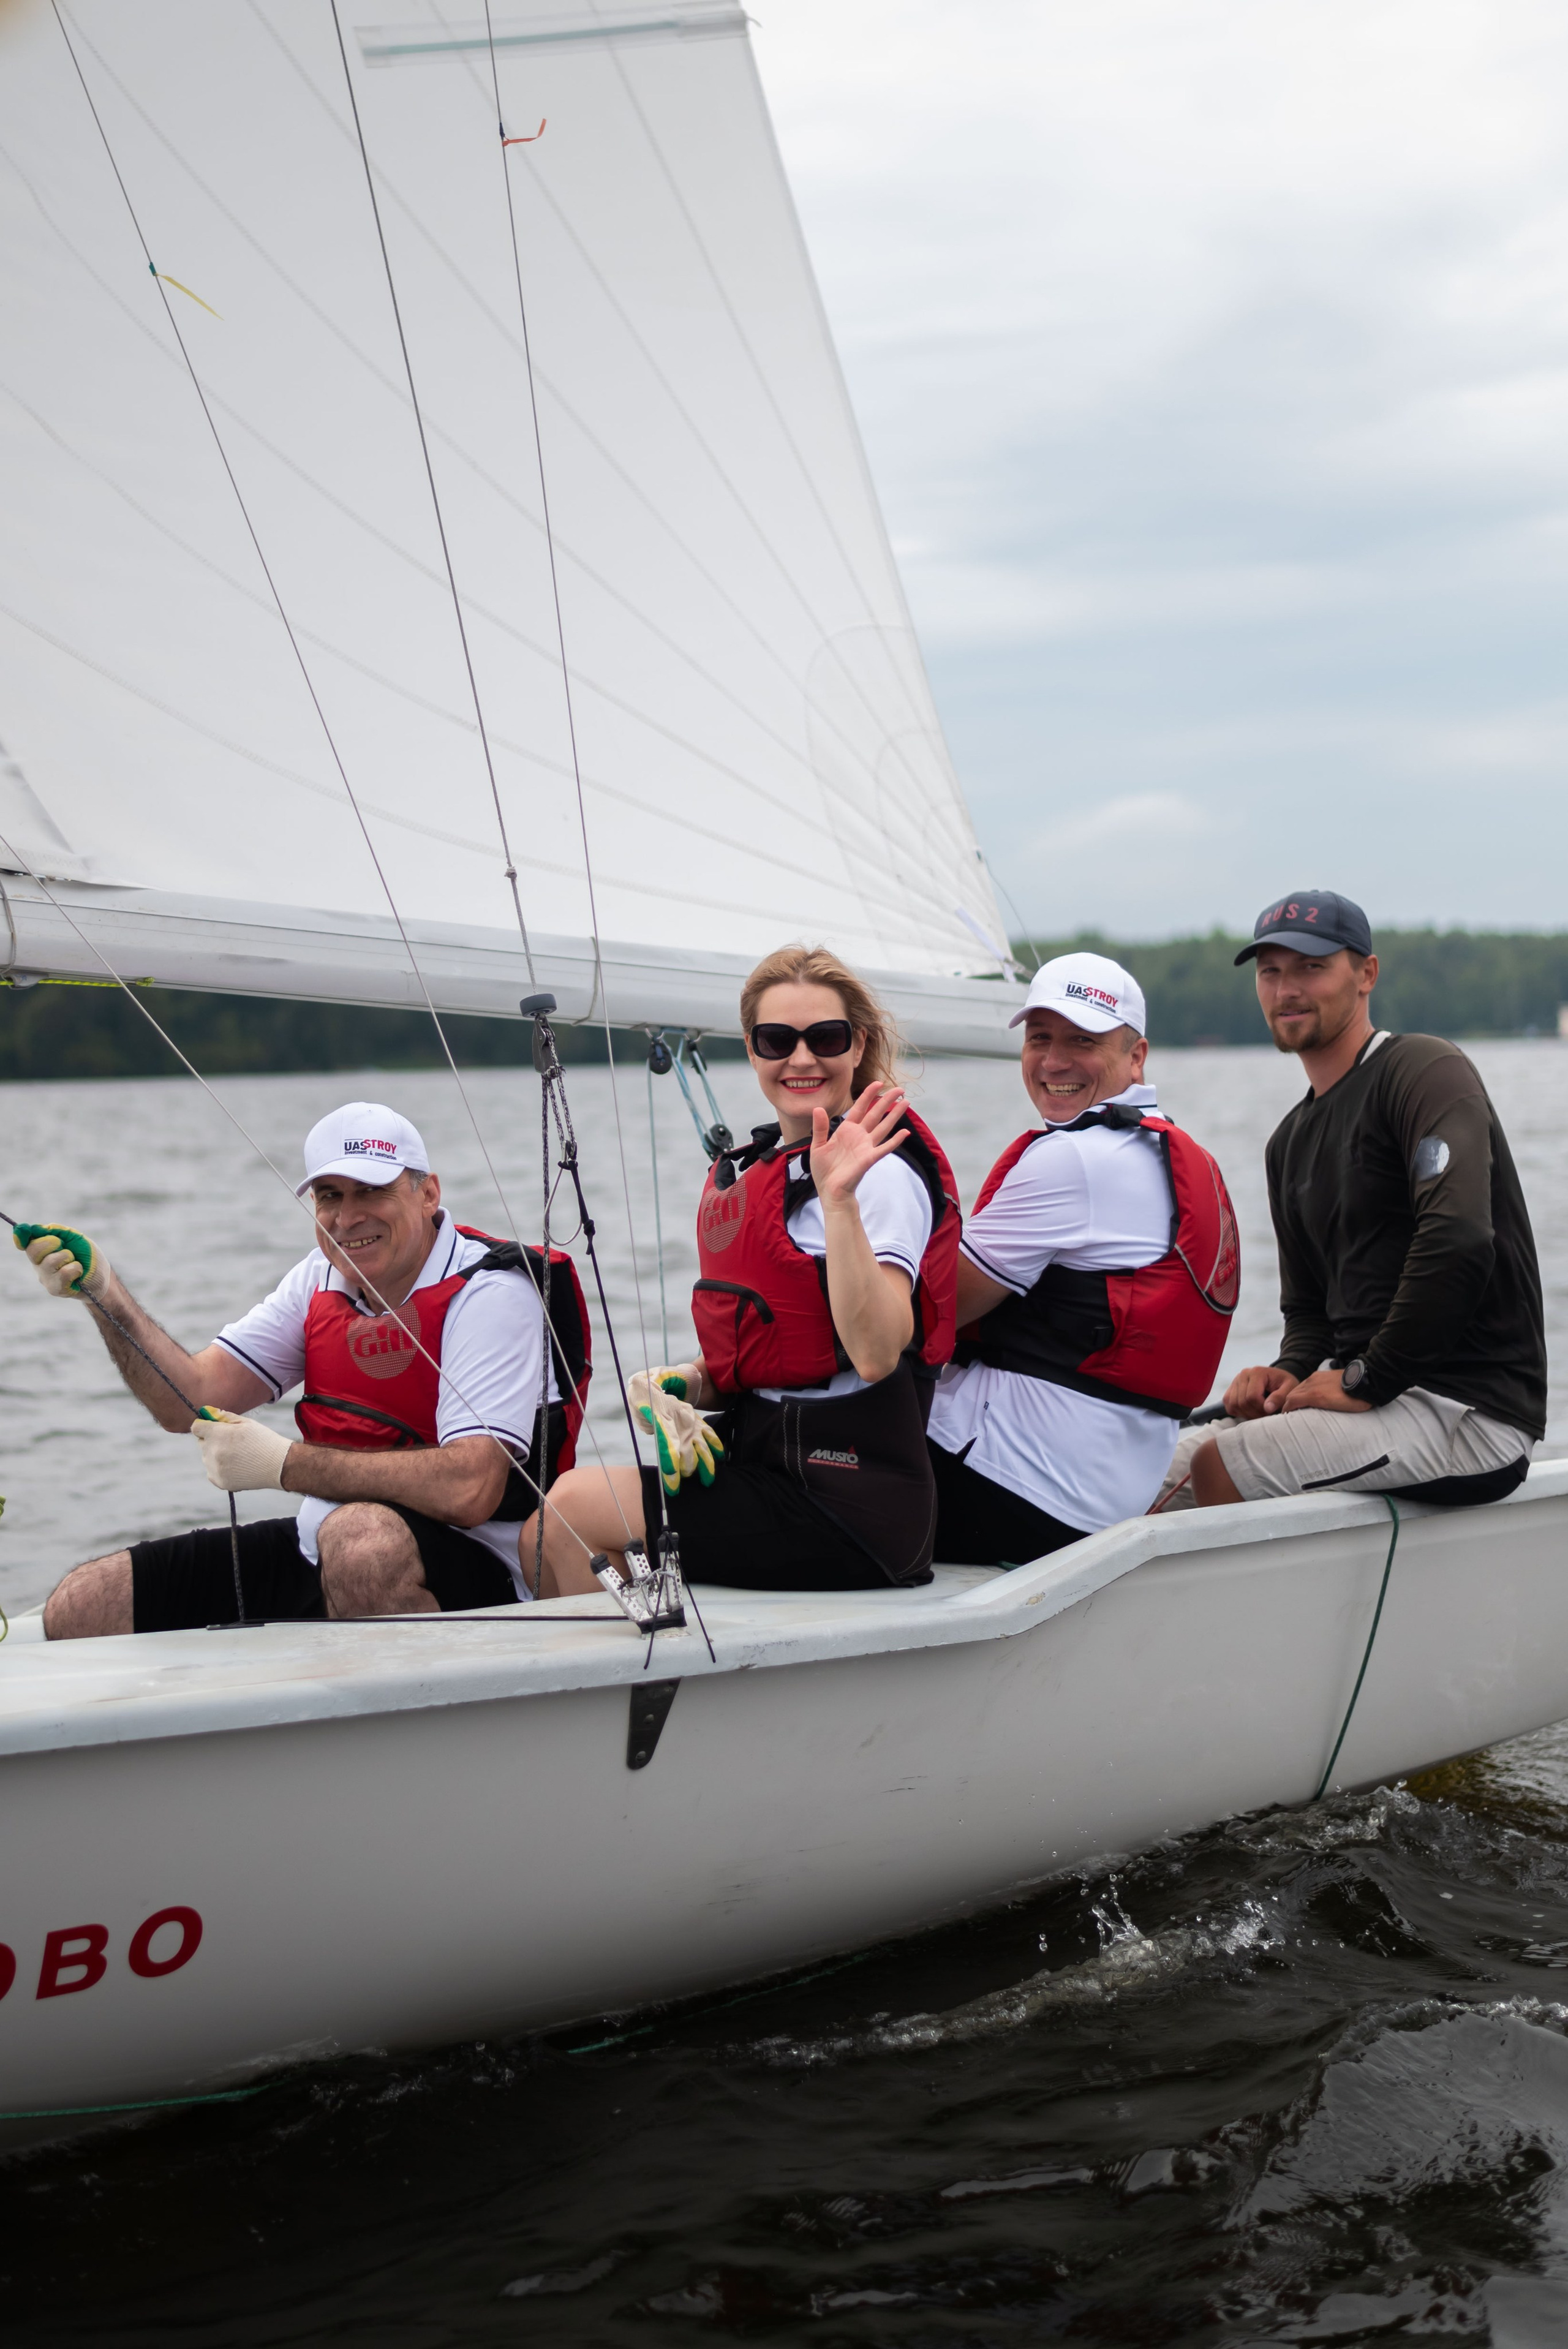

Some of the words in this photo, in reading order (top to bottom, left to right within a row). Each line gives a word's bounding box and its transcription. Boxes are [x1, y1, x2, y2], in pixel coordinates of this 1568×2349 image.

[1261, 903, 1300, 928] RUS
[1305, 907, 1319, 924] 2
[1065, 992, 1088, 1002] investment
[1094, 1001, 1117, 1014] construction
[375, 1152, 397, 1160] construction
[354, 1324, 413, 1357] Gill
[808, 1458, 859, 1469] PERFORMANCE
[809, 1449, 859, 1464] MUSTO
[0, 1906, 203, 2000] BO
